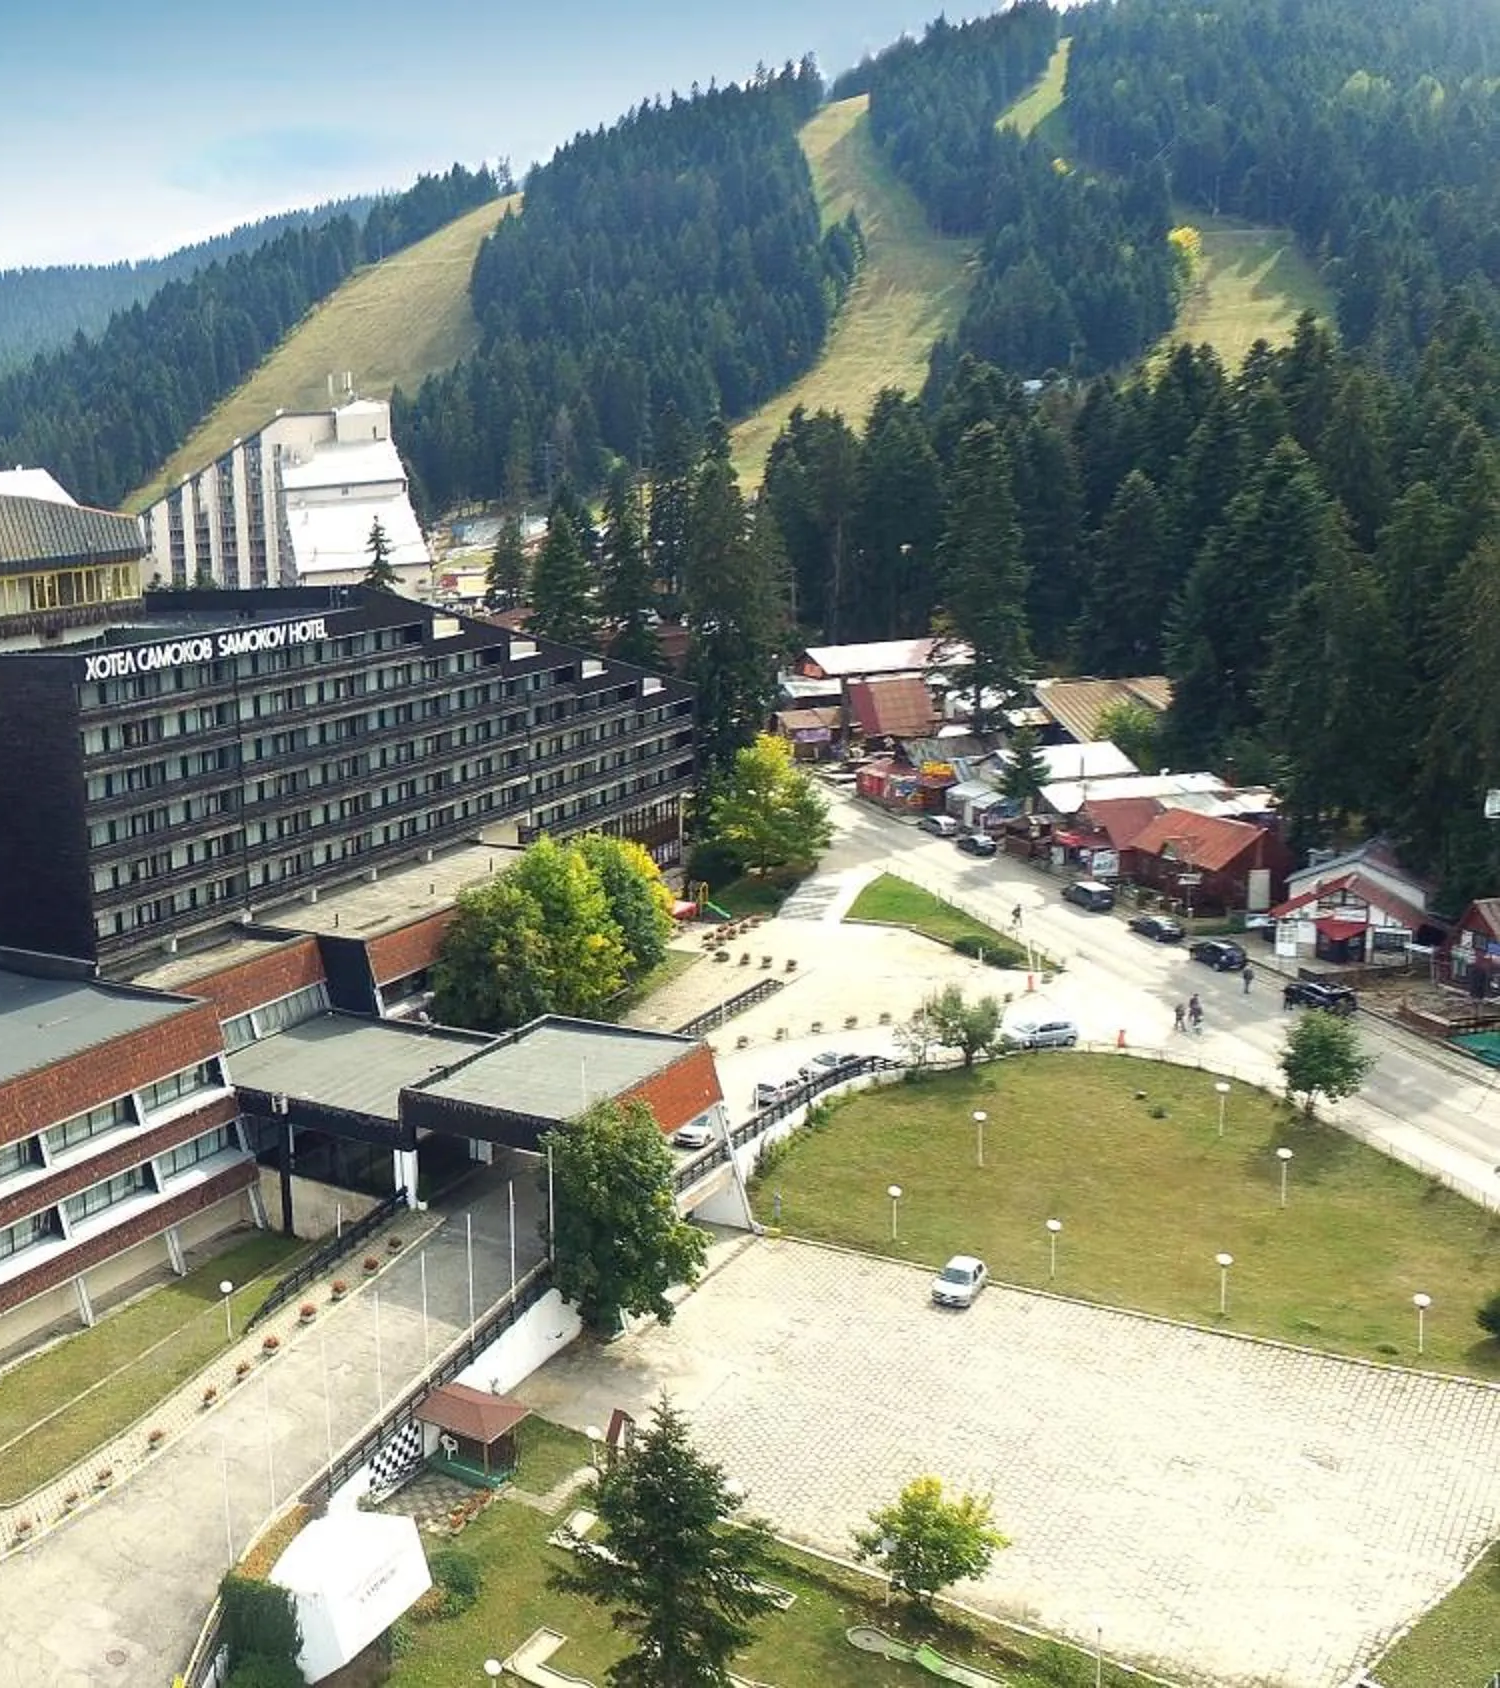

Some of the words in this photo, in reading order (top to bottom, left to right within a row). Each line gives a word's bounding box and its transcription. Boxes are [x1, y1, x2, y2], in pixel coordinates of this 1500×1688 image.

[218, 624, 287, 657] SAMOKOV
[288, 618, 328, 645] HOTEL
[85, 650, 137, 681] ХОТЕЛ
[137, 637, 213, 671] САМОКОВ
